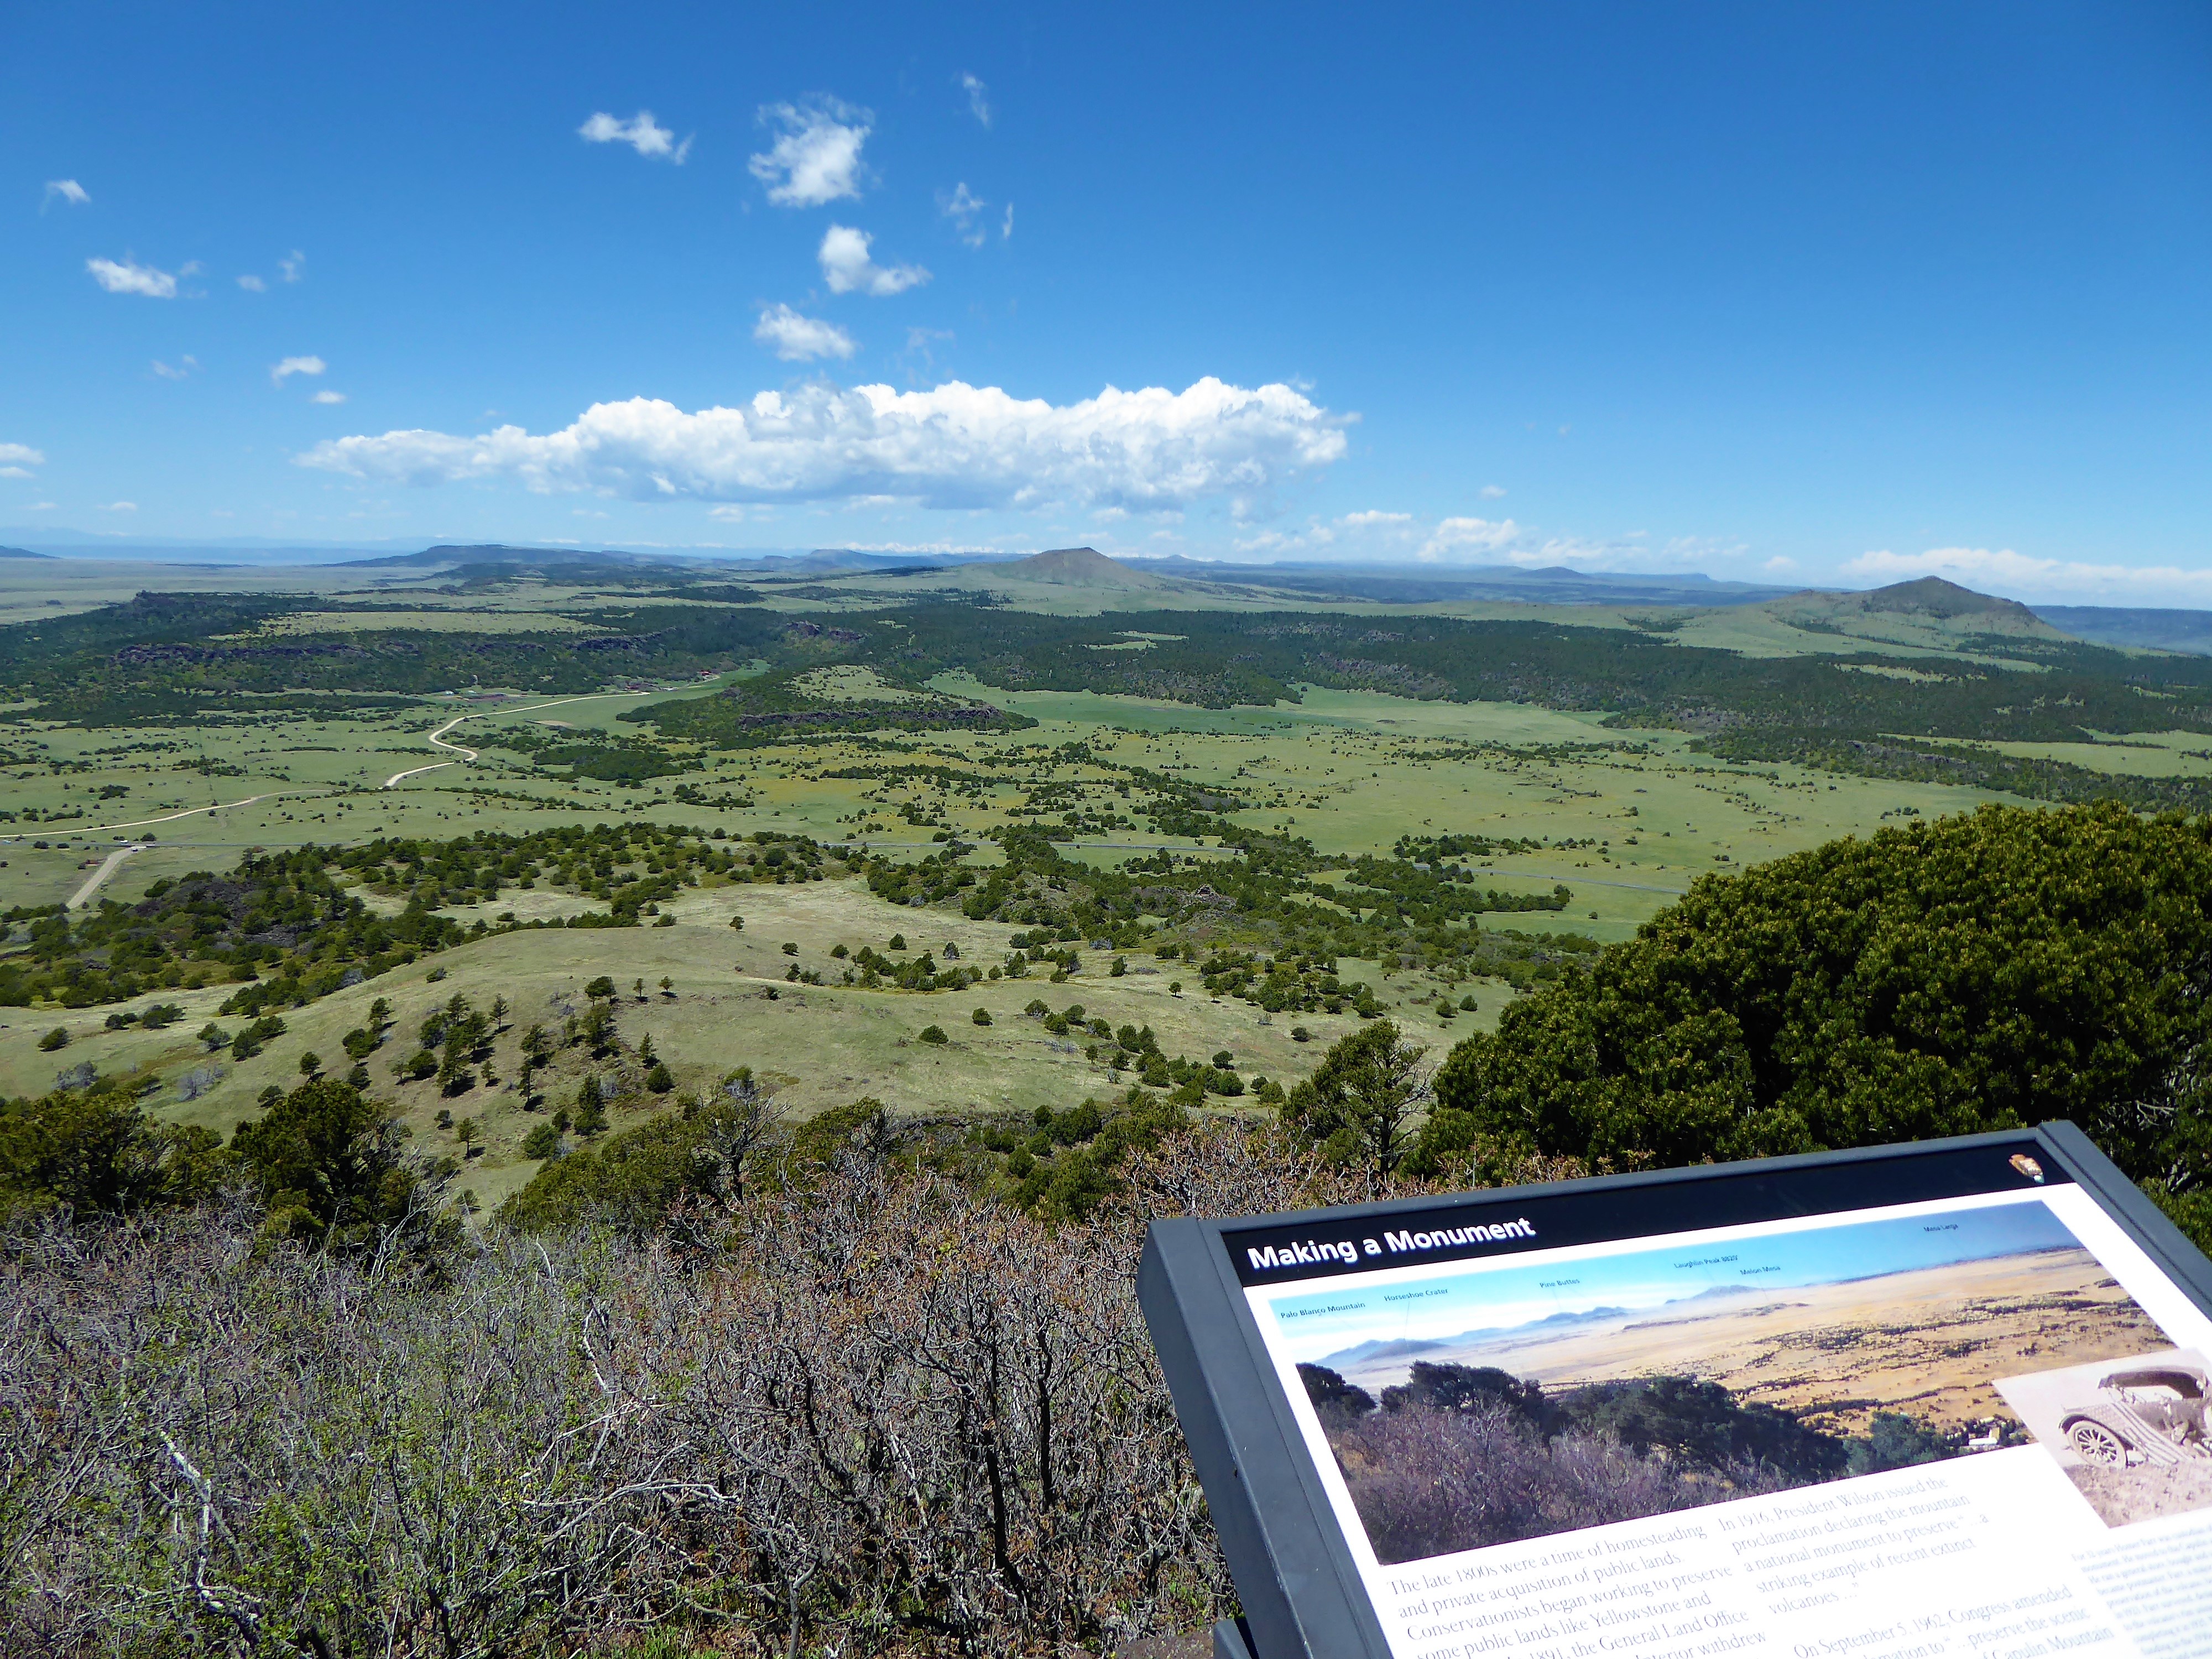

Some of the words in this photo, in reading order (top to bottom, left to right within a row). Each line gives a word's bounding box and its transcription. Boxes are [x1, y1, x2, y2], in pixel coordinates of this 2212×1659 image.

[1248, 1240, 1358, 1269] Making
[1363, 1239, 1381, 1254] a
[1384, 1218, 1536, 1251] Monument
[1327, 1302, 1365, 1312] Mountain
[1384, 1292, 1423, 1301] Horseshoe
[1718, 1519, 1735, 1531] In
[1738, 1512, 1773, 1527] 1916,
[1773, 1500, 1837, 1520] President
[1837, 1493, 1885, 1506] Wilson
[1887, 1482, 1927, 1498] issued
[1926, 1478, 1948, 1489] the
[1732, 1526, 1822, 1556] proclamation
[1824, 1512, 1886, 1532] declaring
[1886, 1507, 1907, 1520] the
[1909, 1494, 1970, 1515] mountain
[1387, 1579, 1420, 1595] The
[1422, 1575, 1452, 1588] late
[1456, 1566, 1498, 1582] 1800s
[1500, 1559, 1537, 1573] were
[1540, 1557, 1550, 1566] a
[1551, 1551, 1584, 1564] time
[1588, 1542, 1603, 1556] of
[1604, 1526, 1707, 1553] homesteading
[1744, 1562, 1754, 1572] a
[1755, 1546, 1811, 1570] national
[1813, 1534, 1886, 1557] monument
[1886, 1532, 1902, 1542] to
[1756, 1574, 1812, 1593] striking
[1812, 1559, 1869, 1581] example
[1870, 1552, 1885, 1568] of
[1887, 1548, 1929, 1565] recent
[1931, 1538, 1976, 1556] extinct
[1399, 1599, 1428, 1618] and
[1432, 1590, 1485, 1616] private
[1489, 1575, 1572, 1600] acquisition
[1575, 1567, 1589, 1582] of
[1593, 1560, 1640, 1583] public
[1640, 1551, 1684, 1569] lands.
[1407, 1606, 1540, 1640] Conservationists
[1540, 1596, 1587, 1614] began
[1589, 1583, 1653, 1603] working
[1652, 1580, 1668, 1590] to
[1672, 1568, 1733, 1592] preserve
[1768, 1593, 1839, 1614] volcanoes
[1464, 1634, 1513, 1659] public
[1514, 1624, 1558, 1644] lands
[1559, 1618, 1588, 1634] like
[1590, 1602, 1681, 1627] Yellowstone
[1683, 1590, 1712, 1609] and
[1571, 1641, 1597, 1657] the
[1599, 1625, 1661, 1650] General
[1662, 1616, 1703, 1638] Land
[1704, 1611, 1749, 1627] Office
[1697, 1632, 1766, 1655] withdrew
[1794, 1645, 1819, 1658] On
[1819, 1628, 1896, 1655] September
[1912, 1614, 1950, 1632] 1962,
[1948, 1602, 2012, 1623] Congress
[2012, 1584, 2073, 1610] amended
[2025, 1616, 2048, 1631] the
[2049, 1609, 2090, 1626] scenic
[2047, 1626, 2115, 1651] Mountain
